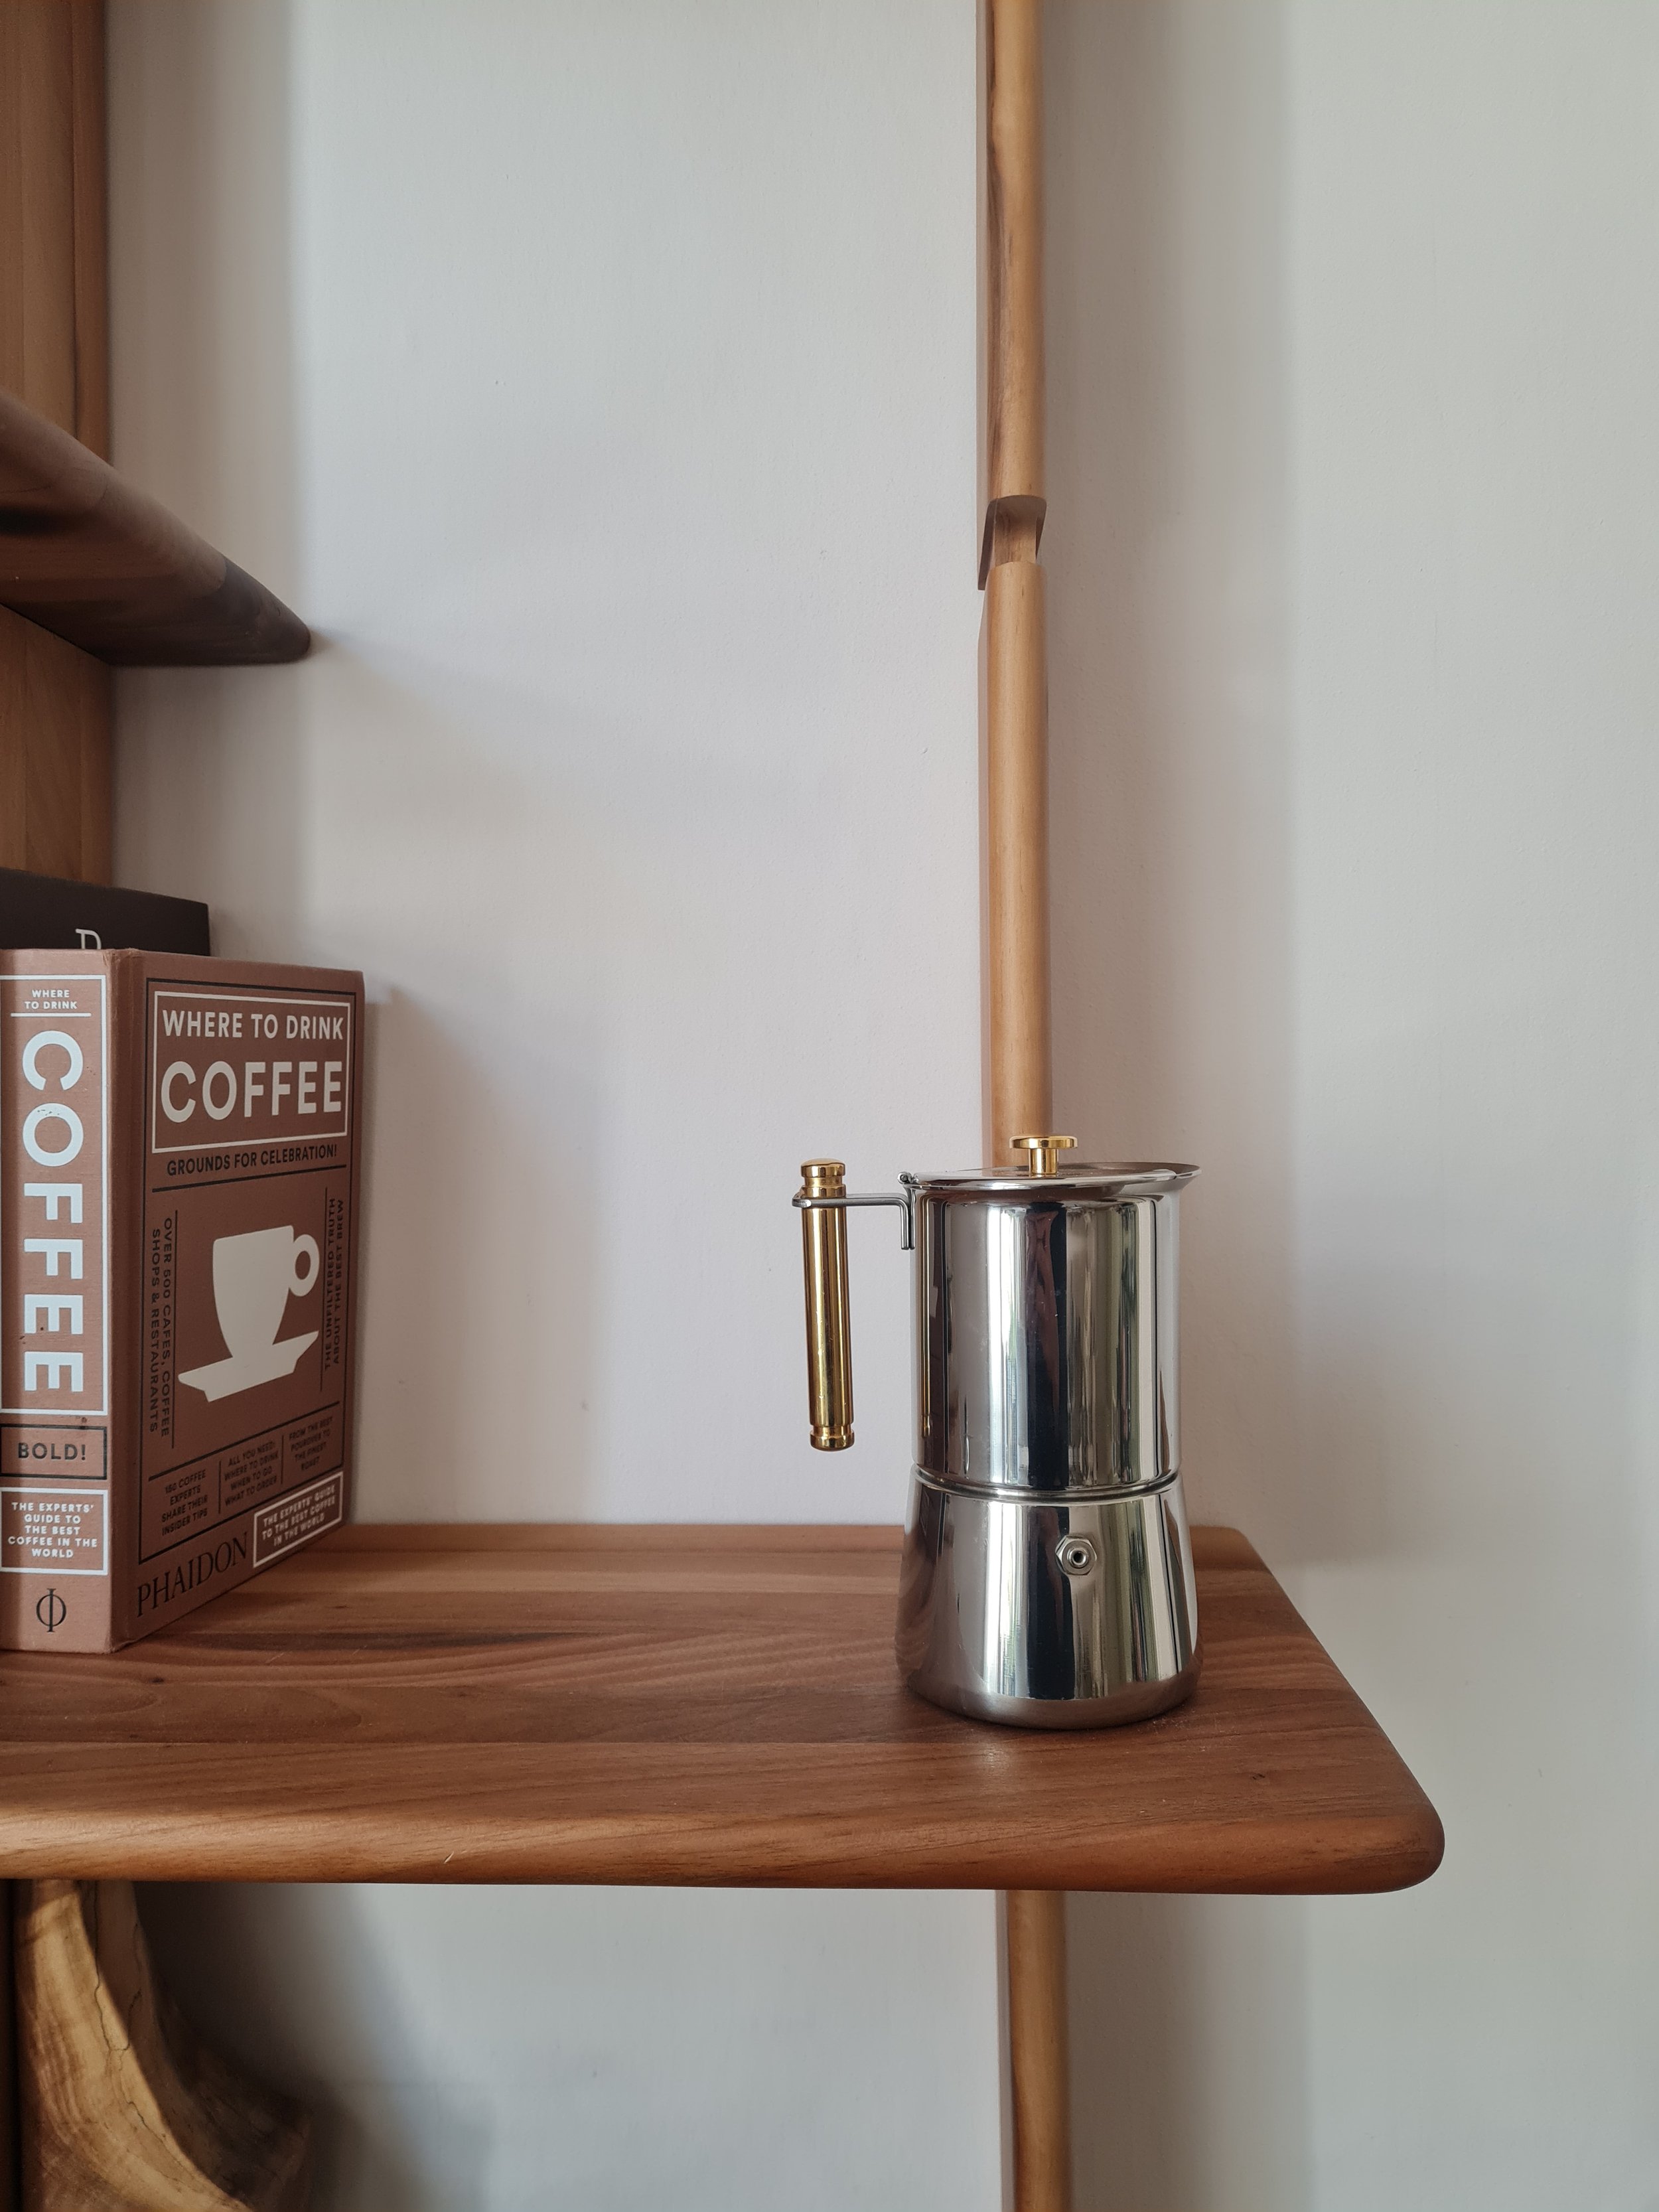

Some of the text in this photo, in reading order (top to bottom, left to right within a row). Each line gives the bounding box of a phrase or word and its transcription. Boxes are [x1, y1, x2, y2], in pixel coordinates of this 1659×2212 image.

[24, 1001, 78, 1009] TO DRINK
[31, 990, 70, 998] WHERE
[163, 1009, 344, 1040] WHERE TO DRINK
[161, 1061, 342, 1123] COFFEE
[167, 1143, 338, 1176] GROUNDS FOR CELEBRATION!
[22, 1030, 84, 1392] COFFEE
[163, 1217, 173, 1263] OVER
[149, 1228, 161, 1432] SHOPS & RESTAURANTS
[161, 1305, 171, 1365] CAFES,
[161, 1371, 171, 1437] COFFEE
[18, 1442, 86, 1461] BOLD!
[179, 1470, 206, 1487] COFFEE
[11, 1502, 94, 1513] THE EXPERTS'
[161, 1495, 207, 1522] SHARE THEIR
[171, 1485, 200, 1506] EXPERTS
[24, 1514, 81, 1524] GUIDE TO
[25, 1525, 80, 1535] THE BEST
[163, 1509, 207, 1536] INSIDER TIPS
[263, 1496, 334, 1540] TO THE BEST COFFEE
[264, 1513, 277, 1526] THE
[274, 1513, 325, 1546] IN THE WORLD
[7, 1536, 98, 1548] COFFEE IN THE
[31, 1548, 74, 1558] WORLD
[137, 1531, 248, 1618] PHAIDON
